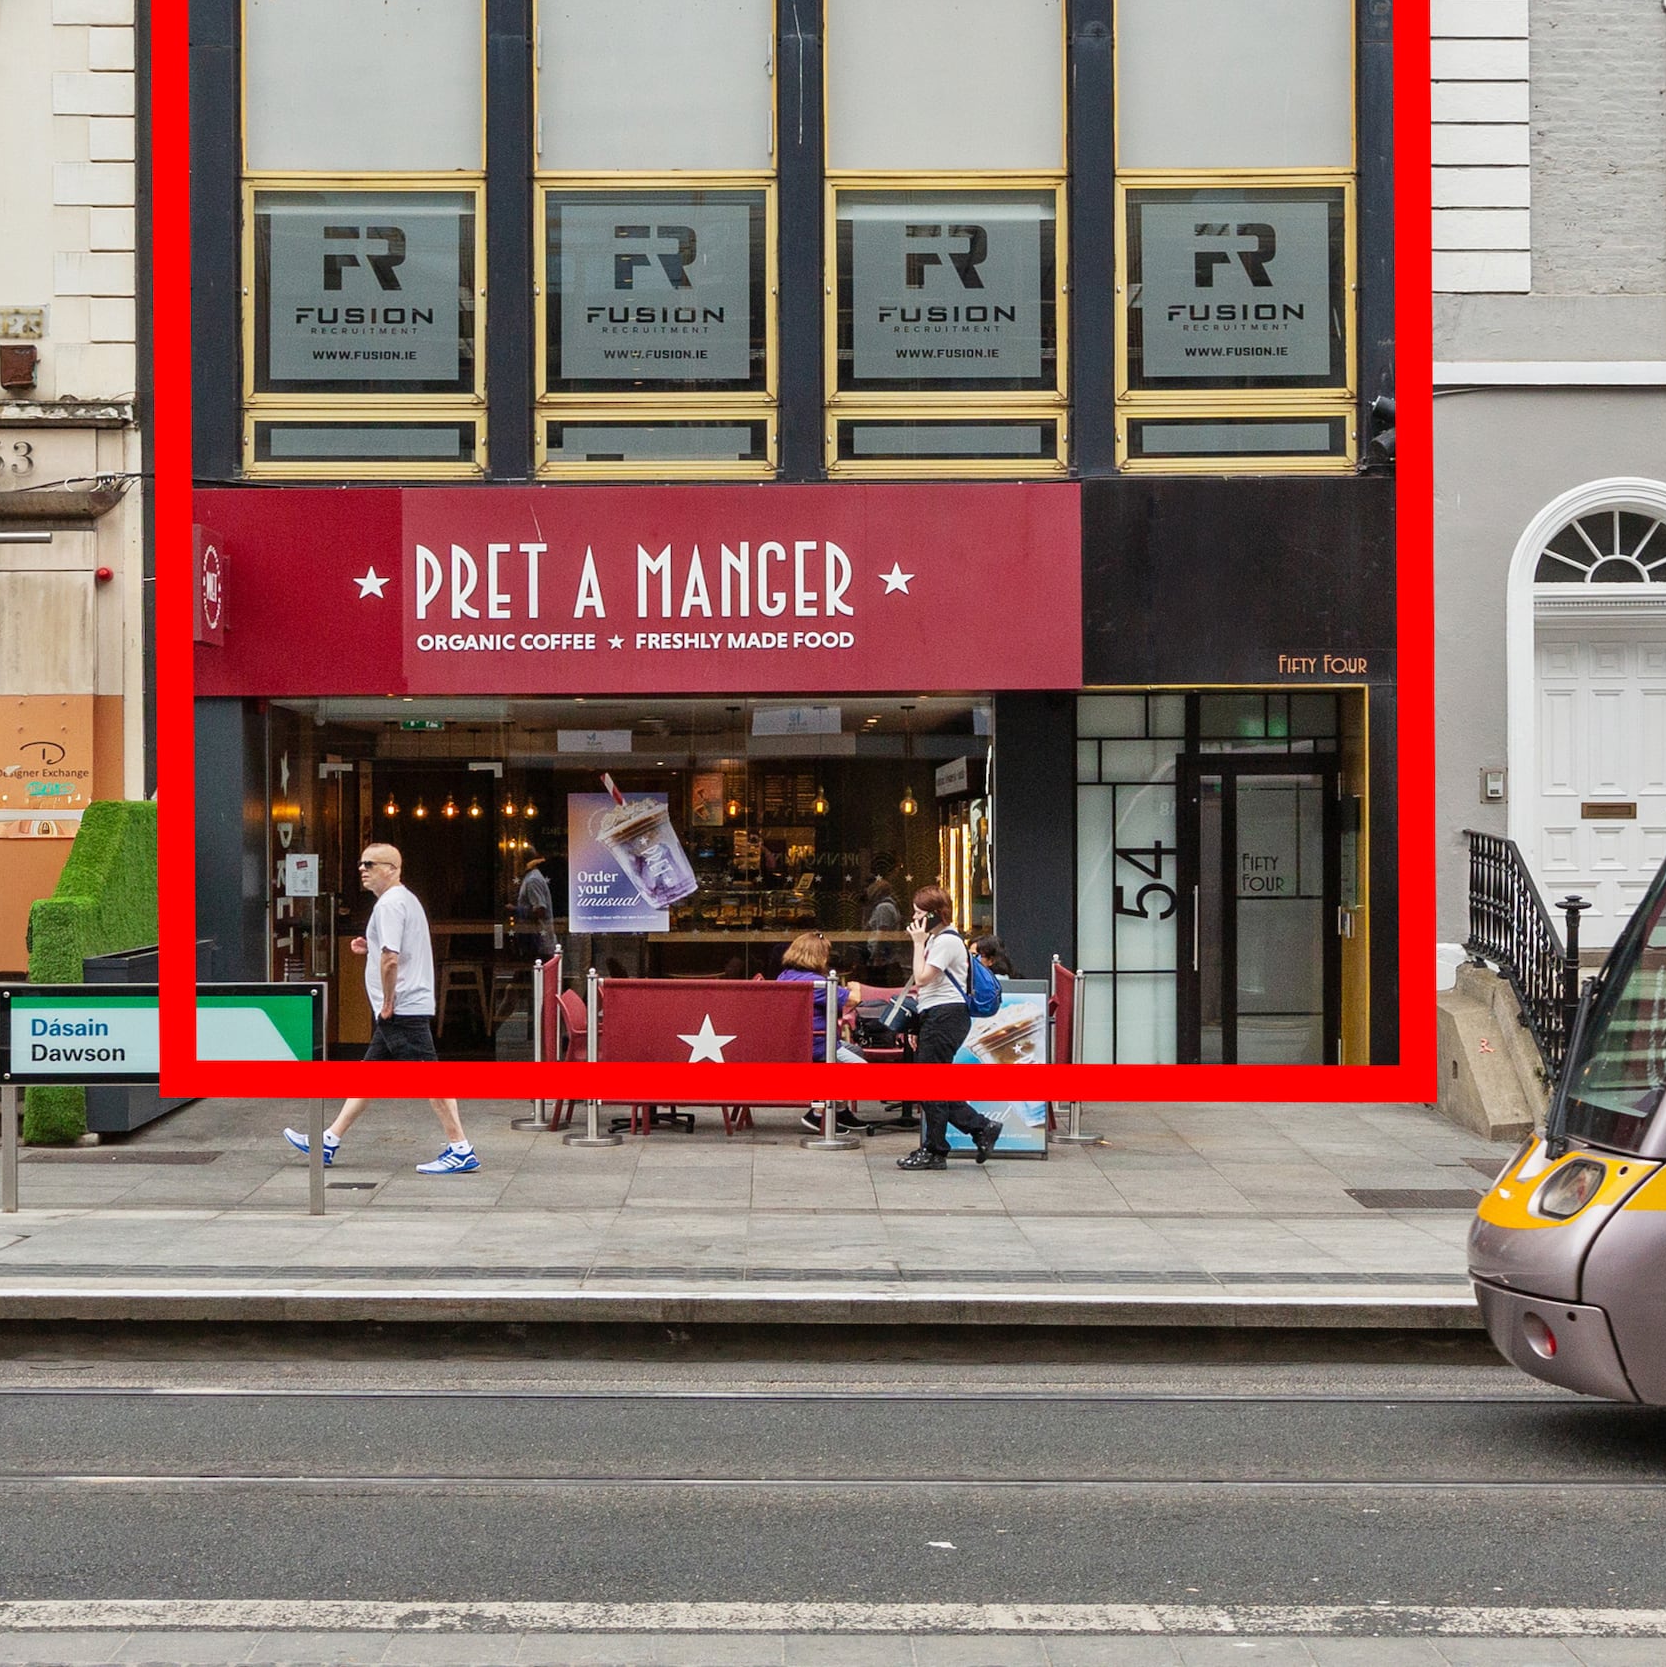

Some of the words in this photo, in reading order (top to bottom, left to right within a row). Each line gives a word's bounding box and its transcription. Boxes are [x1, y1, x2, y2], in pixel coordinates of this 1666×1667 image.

[295, 307, 433, 325] FUSION
[587, 306, 724, 324] FUSION
[878, 305, 1016, 323] FUSION
[1167, 303, 1304, 322] FUSION
[310, 326, 417, 335] RECRUITMENT
[601, 326, 709, 334] RECRUITMENT
[893, 325, 1000, 334] RECRUITMENT
[1182, 323, 1288, 332] RECRUITMENT
[312, 350, 417, 360] WWW.FUSION.IE
[603, 349, 708, 360] WWW.FUSION.IE
[895, 348, 1000, 359] WWW.FUSION.IE
[1184, 346, 1289, 357] WWW.FUSION.IE
[416, 543, 548, 620] PRET
[573, 545, 606, 618] A
[637, 540, 854, 618] MANGER
[416, 634, 516, 651] ORGANIC
[520, 633, 596, 650] COFFEE
[636, 632, 723, 650] FRESHLY
[727, 632, 788, 649] MADE
[793, 631, 855, 648] FOOD
[1278, 654, 1317, 674] FIFTY
[1323, 654, 1368, 674] FOUR
[42, 768, 90, 780] Exchange
[1242, 853, 1279, 871] FIFTY
[577, 871, 619, 883] Order
[1115, 840, 1178, 921] 54
[1242, 876, 1284, 892] FOUR
[577, 884, 611, 898] your
[576, 893, 642, 908] unusual
[31, 1018, 109, 1037] Dásain
[31, 1043, 126, 1062] Dawson
